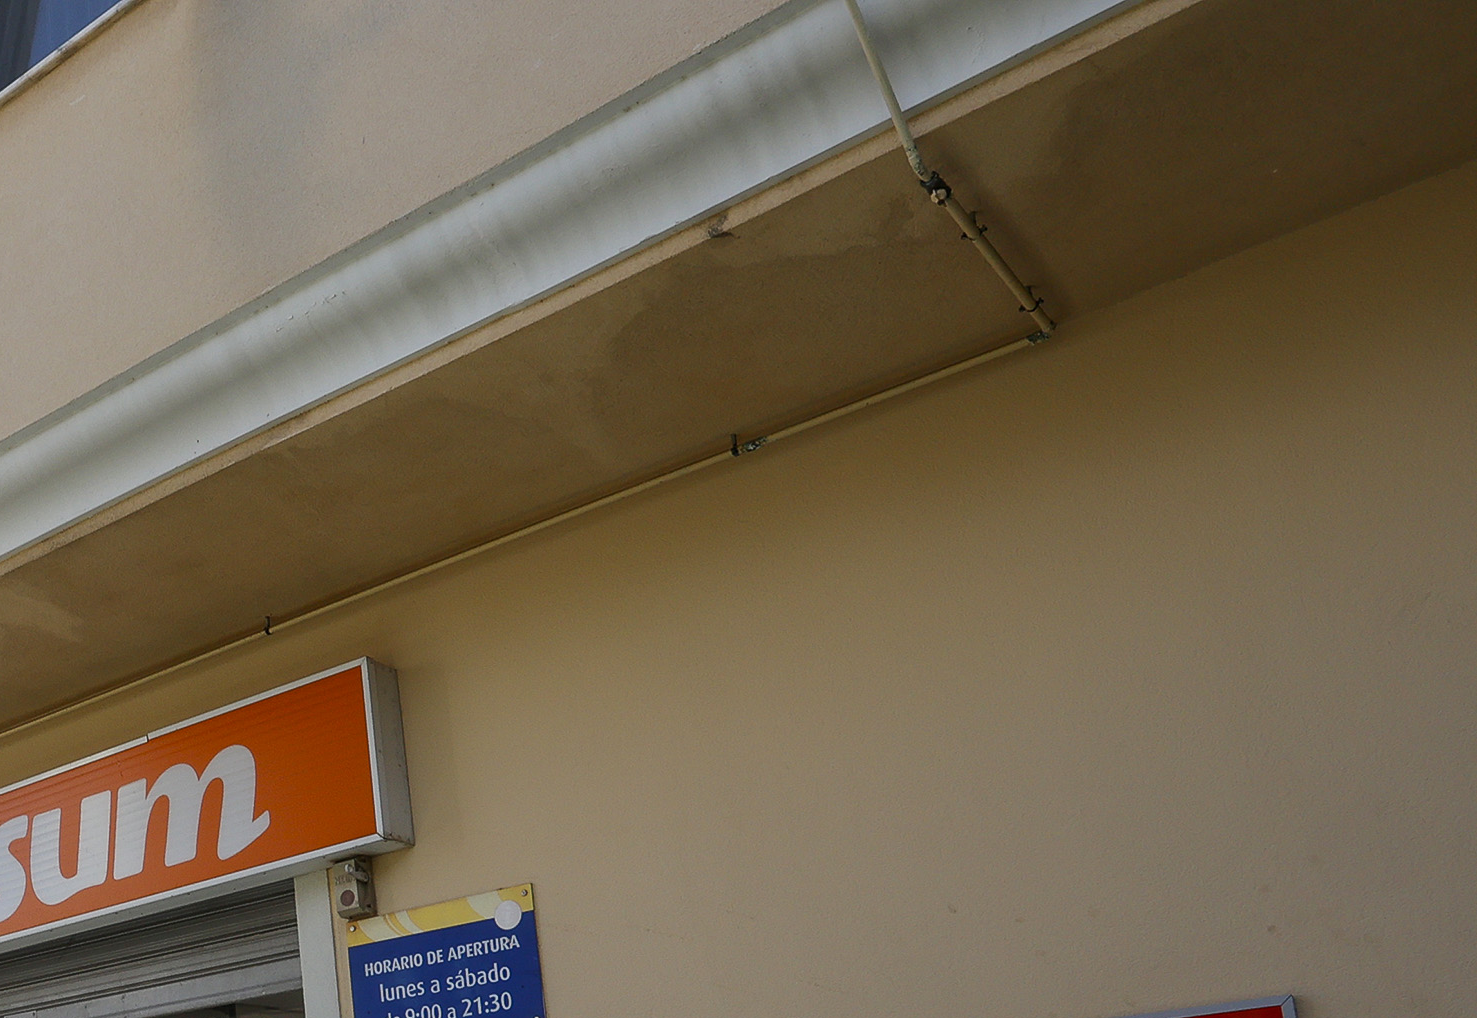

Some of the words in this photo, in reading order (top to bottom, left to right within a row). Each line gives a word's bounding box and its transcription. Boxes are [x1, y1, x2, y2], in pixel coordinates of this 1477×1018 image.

[364, 953, 423, 977] HORARIO
[426, 949, 444, 966] DE
[447, 934, 520, 962] APERTURA
[379, 982, 425, 1003] lunes
[430, 978, 441, 994] a
[446, 962, 511, 992] sábado
[461, 991, 513, 1018] 21:30
